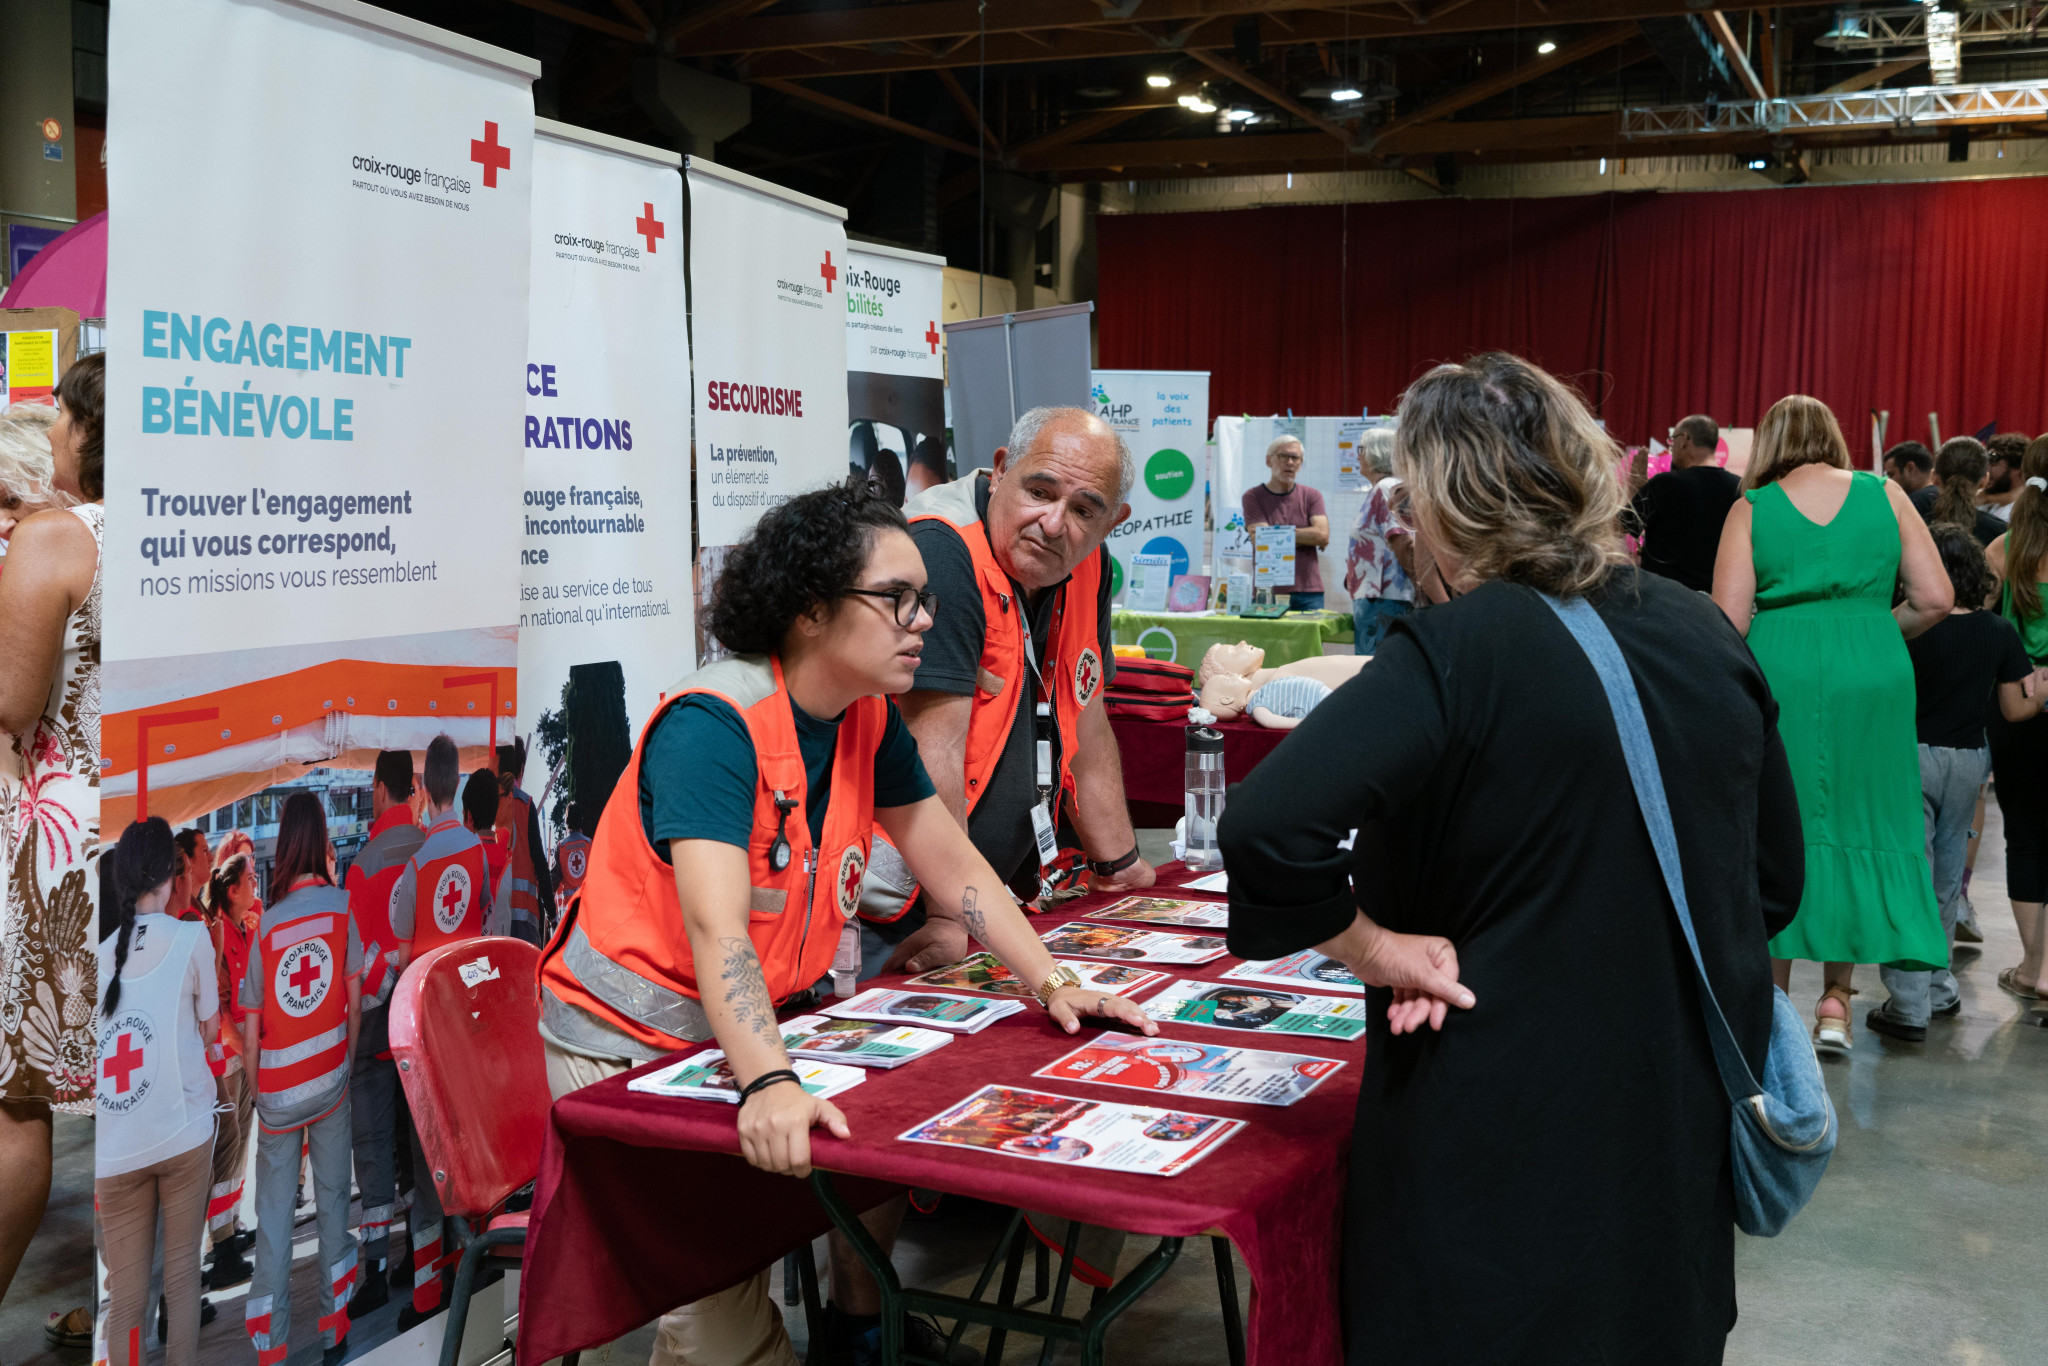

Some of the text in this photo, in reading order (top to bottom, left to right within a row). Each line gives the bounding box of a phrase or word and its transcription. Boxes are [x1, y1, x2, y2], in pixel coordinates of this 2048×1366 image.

[352, 155, 471, 194] croix-rouge française
[352, 180, 470, 212] PARTOUT OÙ VOUS AVEZ BESOIN DE NOUS
[554, 233, 640, 259] croix-rouge française
[846, 291, 884, 317] bilités
[142, 309, 412, 379] ENGAGEMENT
[878, 347, 907, 359] croix-rouge
[526, 363, 558, 398] CE
[141, 375, 354, 442] BÉNÉVOLE
[707, 380, 803, 418] SECOURISME
[1156, 391, 1189, 401] la voix
[1163, 404, 1181, 414] des
[1099, 404, 1132, 418] AHP
[1109, 418, 1140, 426] FRANCE
[1151, 416, 1192, 427] patients
[524, 415, 633, 452] RATIONS
[710, 443, 778, 466] La prévention,
[711, 468, 769, 485] un élément-clé
[1155, 470, 1184, 481] soutien
[141, 487, 413, 523] Trouver l'engagement
[523, 485, 643, 512] ouge française,
[712, 491, 725, 507] du
[727, 491, 759, 510] dispositif
[525, 513, 645, 536] incontournable
[140, 525, 396, 567] qui vous correspond,
[521, 548, 549, 566] nce
[140, 560, 438, 597] nos missions vous ressemblent
[519, 577, 653, 601] ise au service de tous
[531, 605, 584, 627] national
[585, 598, 672, 626] qu'international.
[437, 870, 468, 900] CROIX-ROUGE
[438, 902, 467, 926] FRANÇAISE
[281, 942, 329, 977] CROIX-ROUGE
[282, 980, 327, 1010] FRANÇAISE
[97, 1016, 154, 1060] CROIX-ROUGE
[97, 1079, 151, 1112] FRANÇAISE
